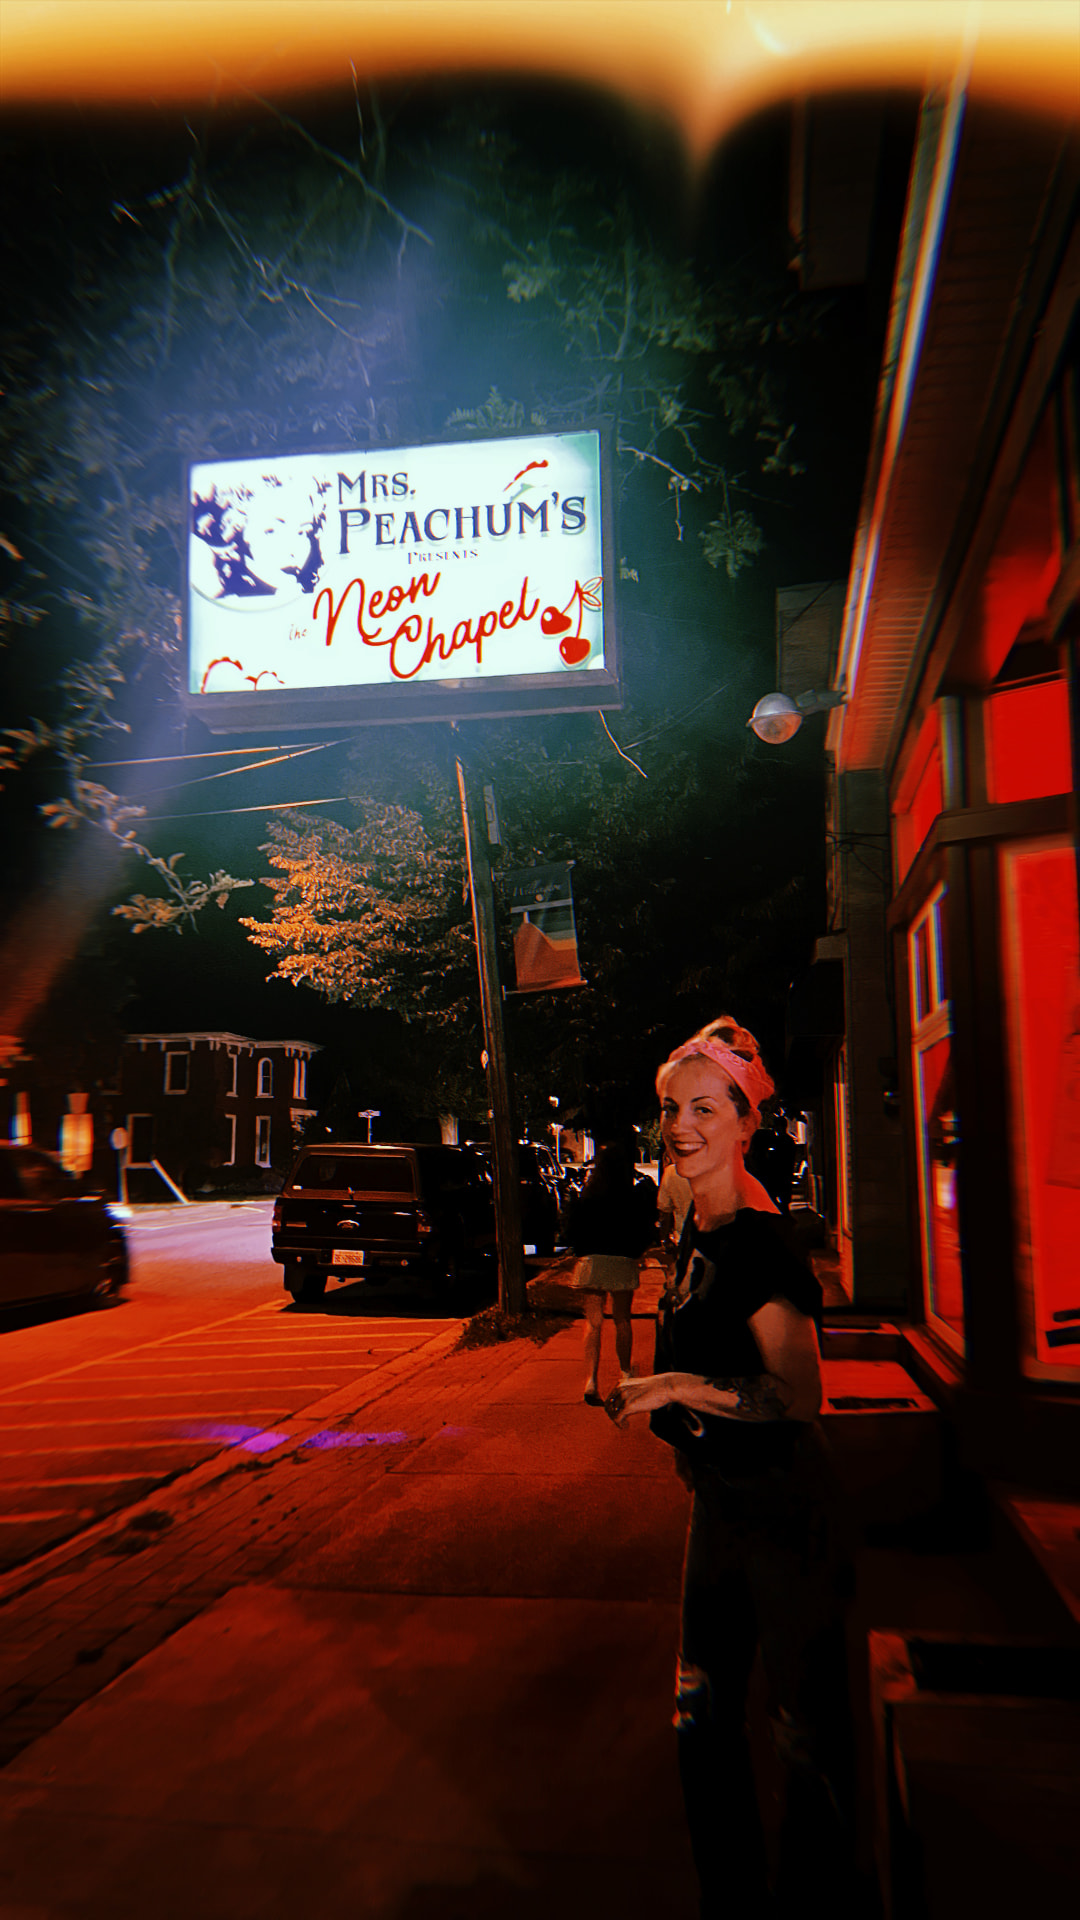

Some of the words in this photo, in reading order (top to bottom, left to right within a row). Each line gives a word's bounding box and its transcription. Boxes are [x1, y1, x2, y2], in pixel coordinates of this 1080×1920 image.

[337, 470, 417, 505] MRS.
[338, 491, 588, 555] PEACHUM'S
[312, 571, 441, 647] Neon
[362, 576, 541, 680] Chapel
